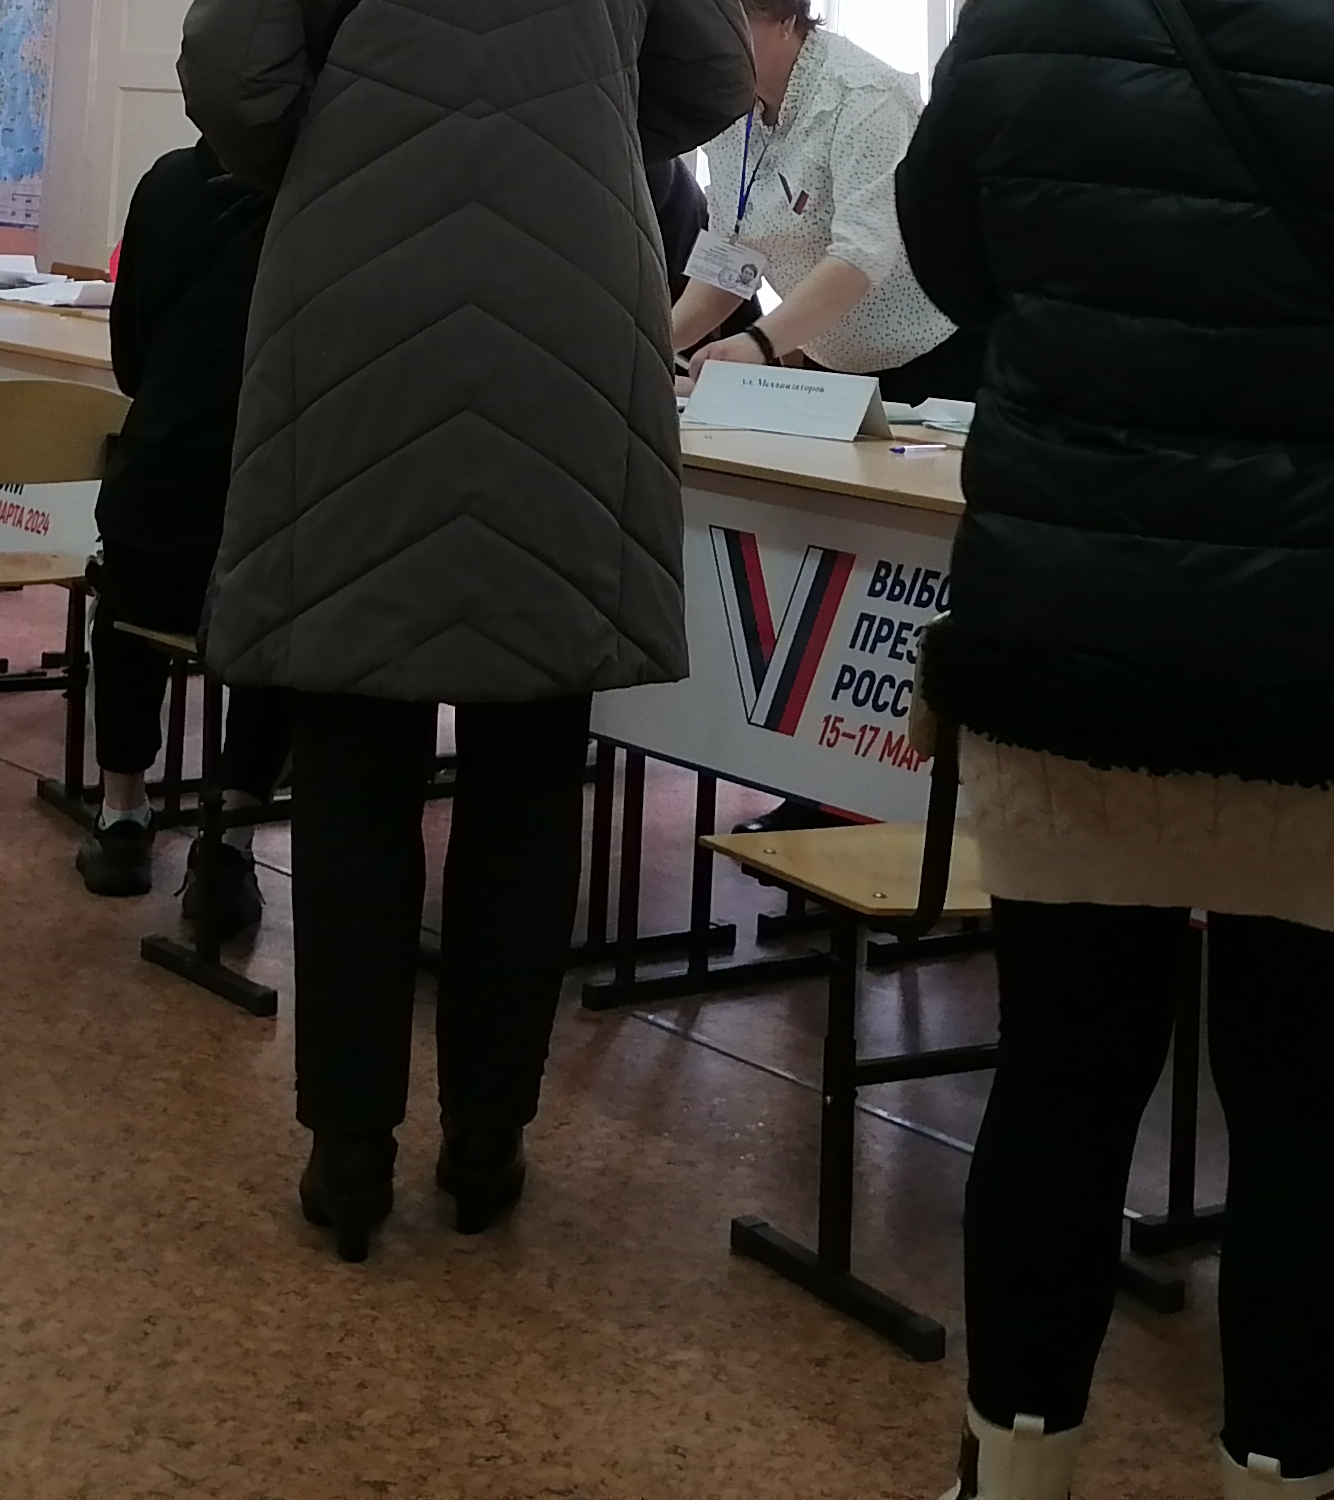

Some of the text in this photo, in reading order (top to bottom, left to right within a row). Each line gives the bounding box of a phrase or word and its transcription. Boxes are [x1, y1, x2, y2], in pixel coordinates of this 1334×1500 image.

[24, 507, 51, 536] 2024
[867, 559, 951, 613] ВЫБО
[831, 664, 914, 718] РОСС
[818, 713, 880, 758] 15–17
